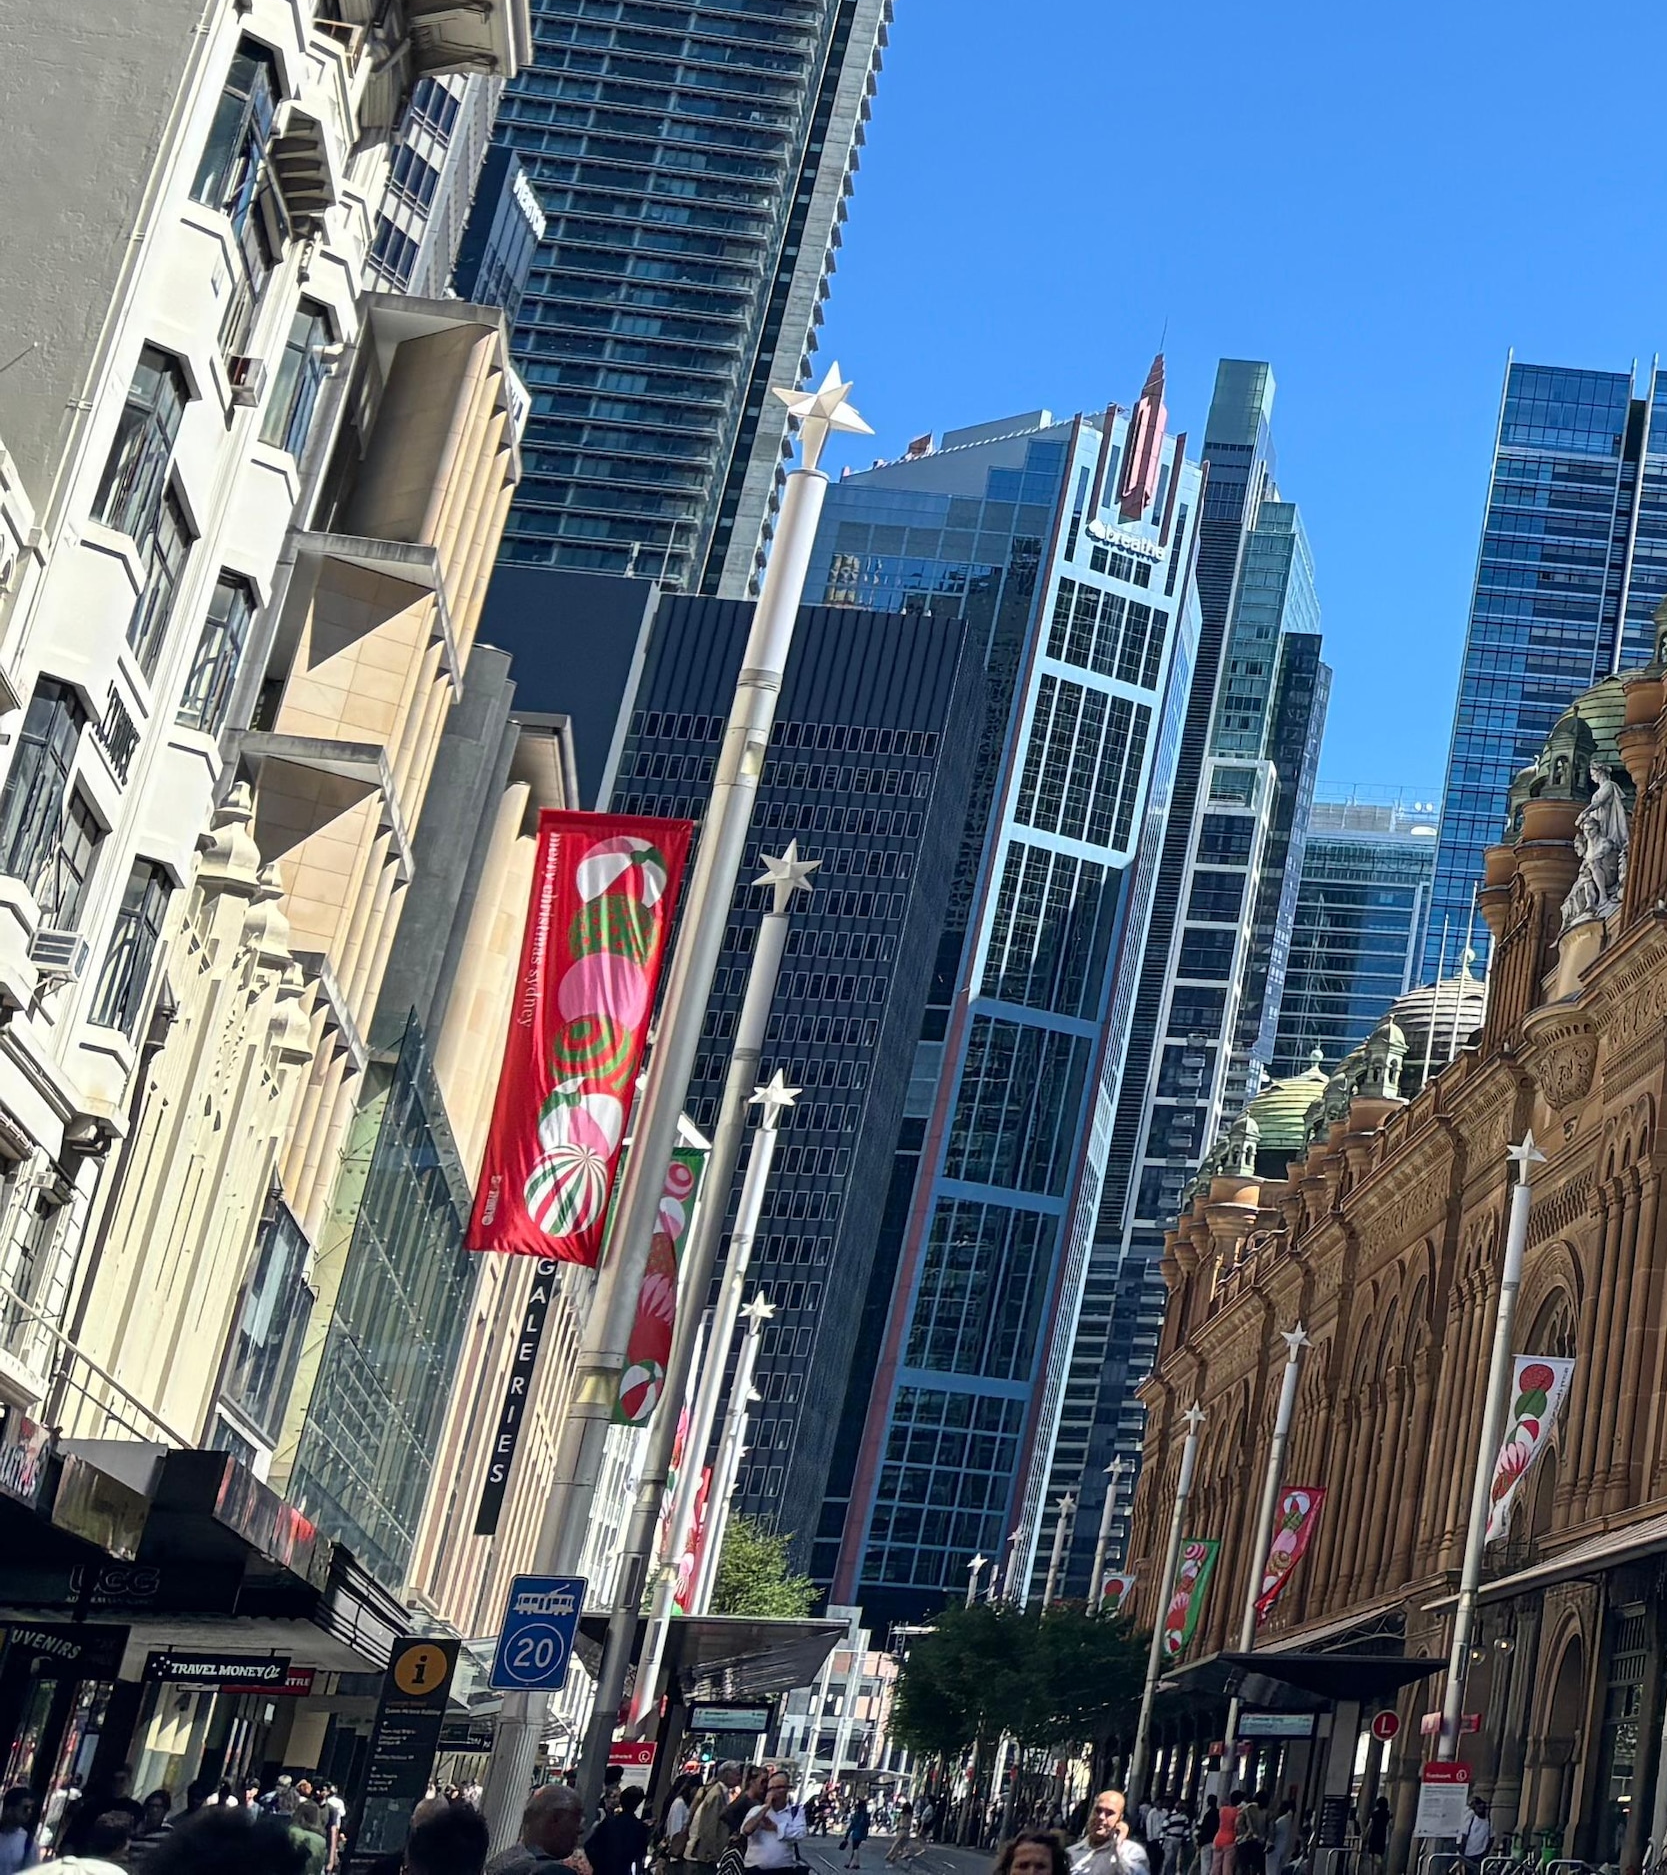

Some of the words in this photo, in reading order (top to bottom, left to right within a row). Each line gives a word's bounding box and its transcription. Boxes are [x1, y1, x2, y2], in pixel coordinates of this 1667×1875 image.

[541, 832, 560, 879] merry
[530, 881, 558, 963] christmas
[517, 963, 542, 1028] sydney
[171, 1662, 218, 1675] TRAVEL
[218, 1665, 266, 1677] MONEY
[513, 1637, 554, 1668] 20
